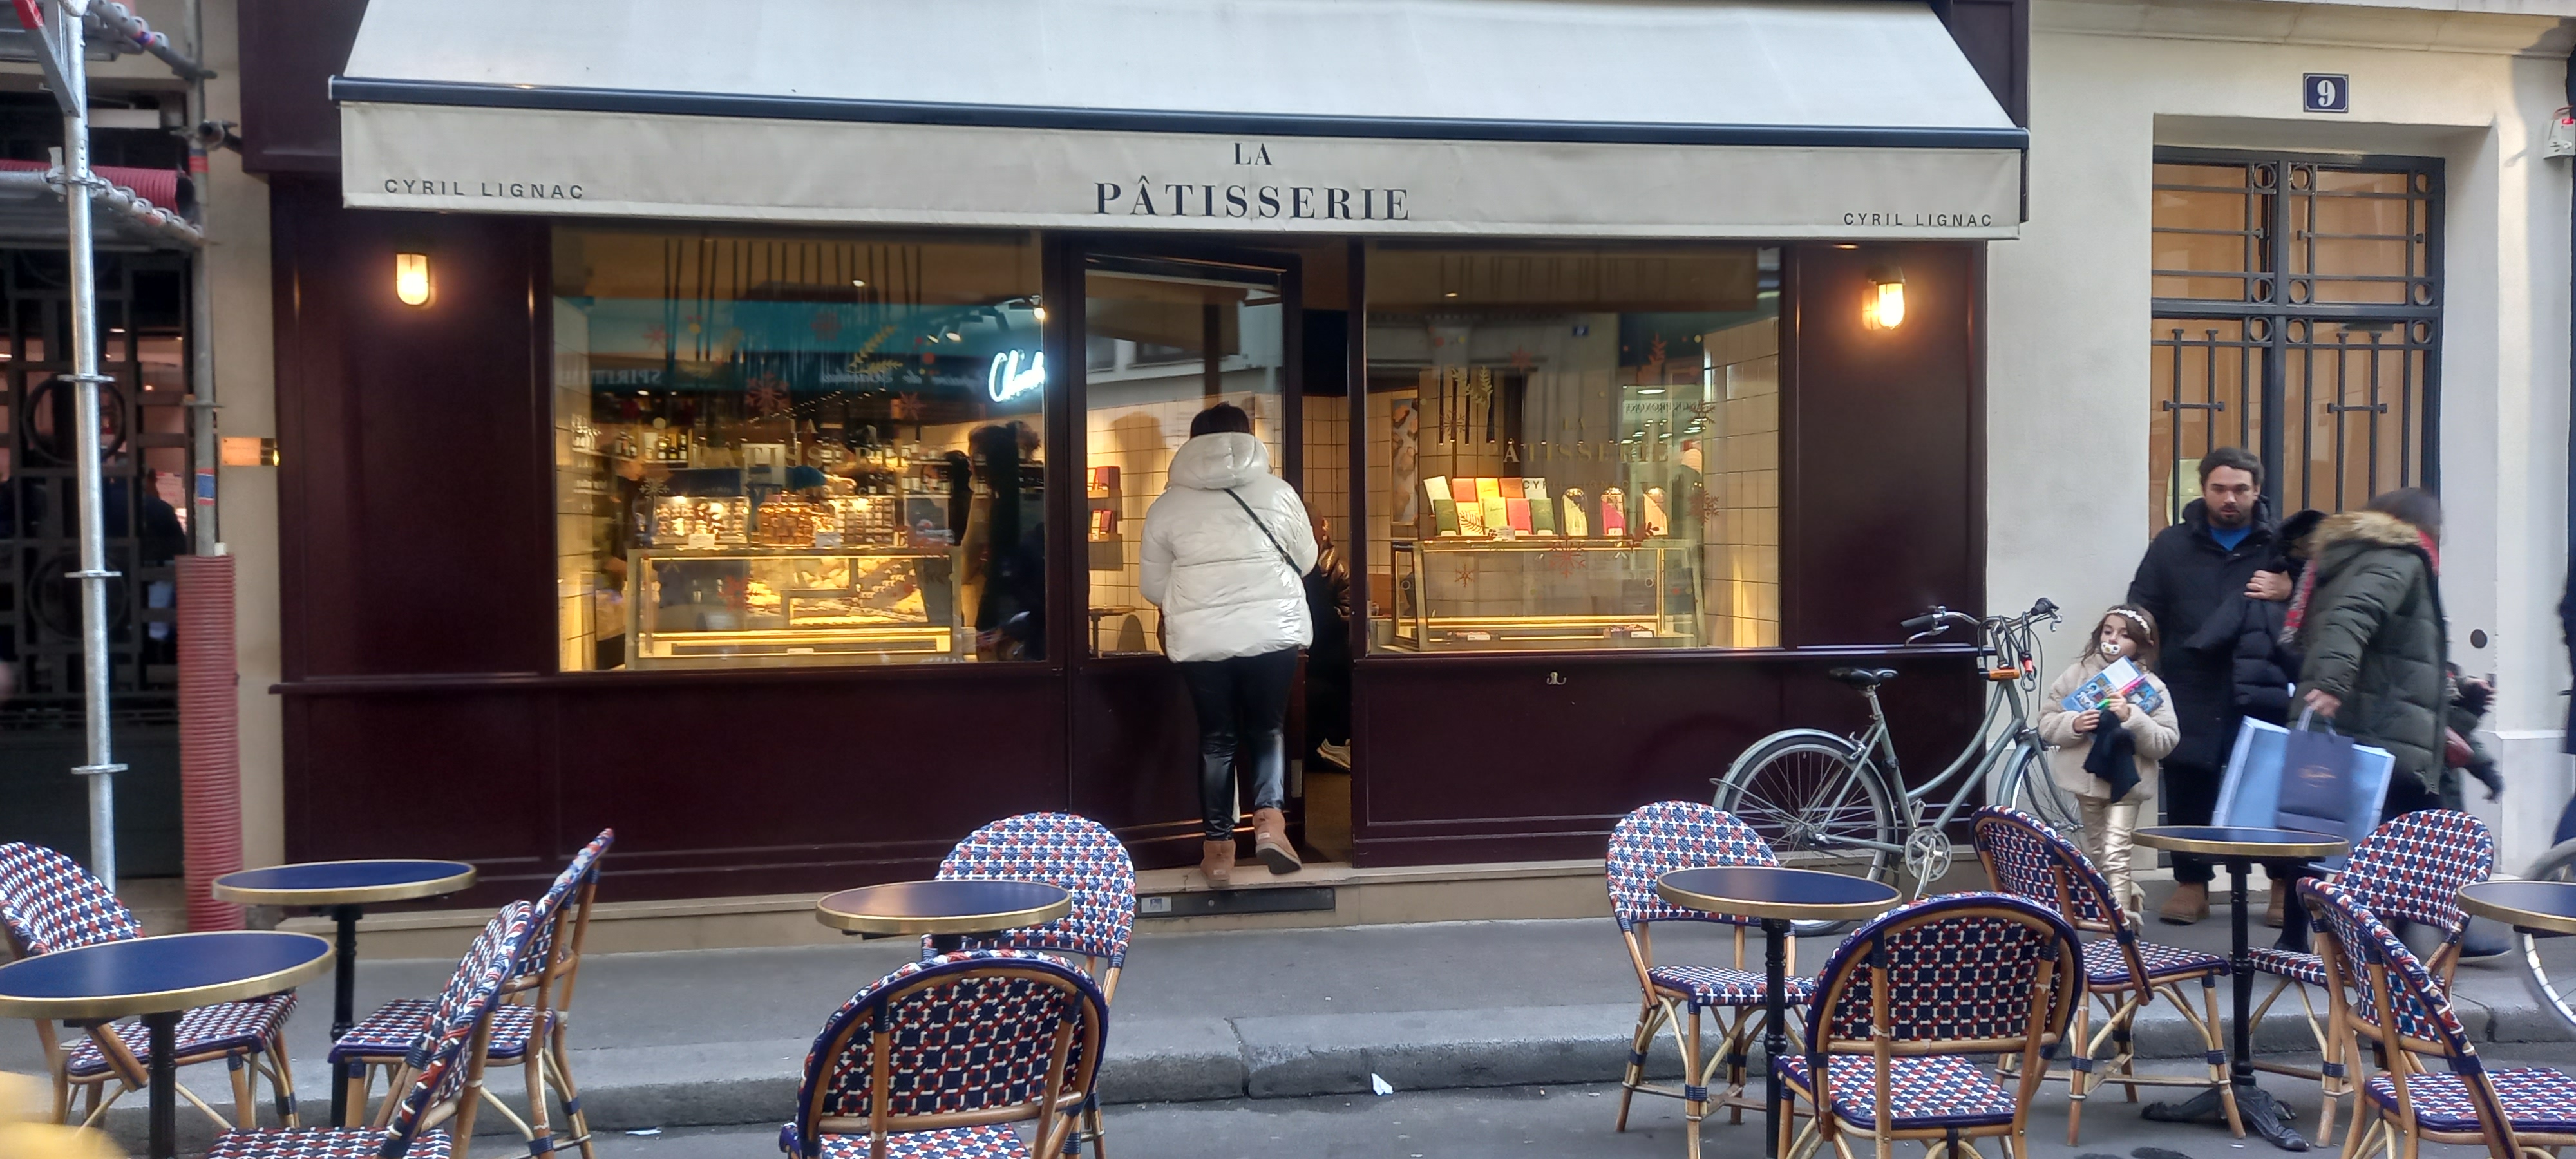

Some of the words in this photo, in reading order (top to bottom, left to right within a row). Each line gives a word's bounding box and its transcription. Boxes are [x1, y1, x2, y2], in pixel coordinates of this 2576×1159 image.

[2318, 80, 2336, 108] 9
[1234, 142, 1272, 166] LA
[384, 178, 465, 196] CYRIL
[481, 182, 583, 200] LIGNAC
[1094, 174, 1408, 220] PÂTISSERIE
[1843, 212, 1904, 226] CYRIL
[1915, 213, 1992, 227] LIGNAC
